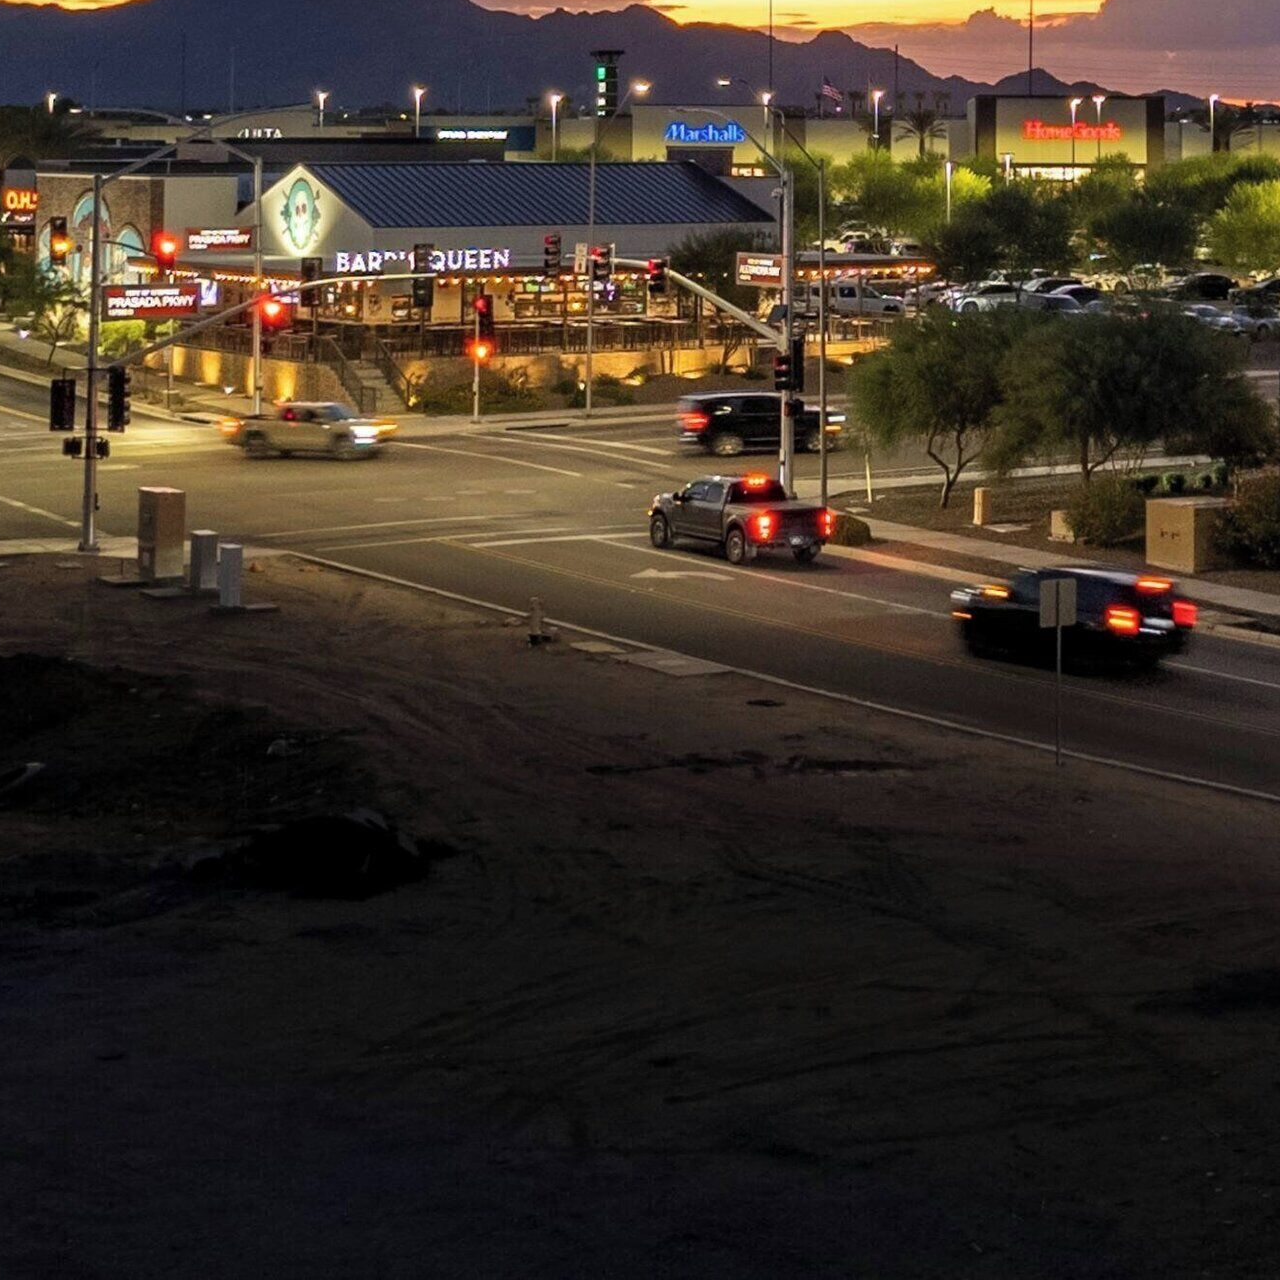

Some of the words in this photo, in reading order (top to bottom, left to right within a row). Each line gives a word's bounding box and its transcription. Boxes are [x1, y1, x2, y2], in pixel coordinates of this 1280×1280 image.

[665, 124, 745, 141] Marshalls
[429, 249, 510, 271] QUEEN
[108, 296, 160, 308] PRASADA
[161, 295, 196, 307] PKWY
